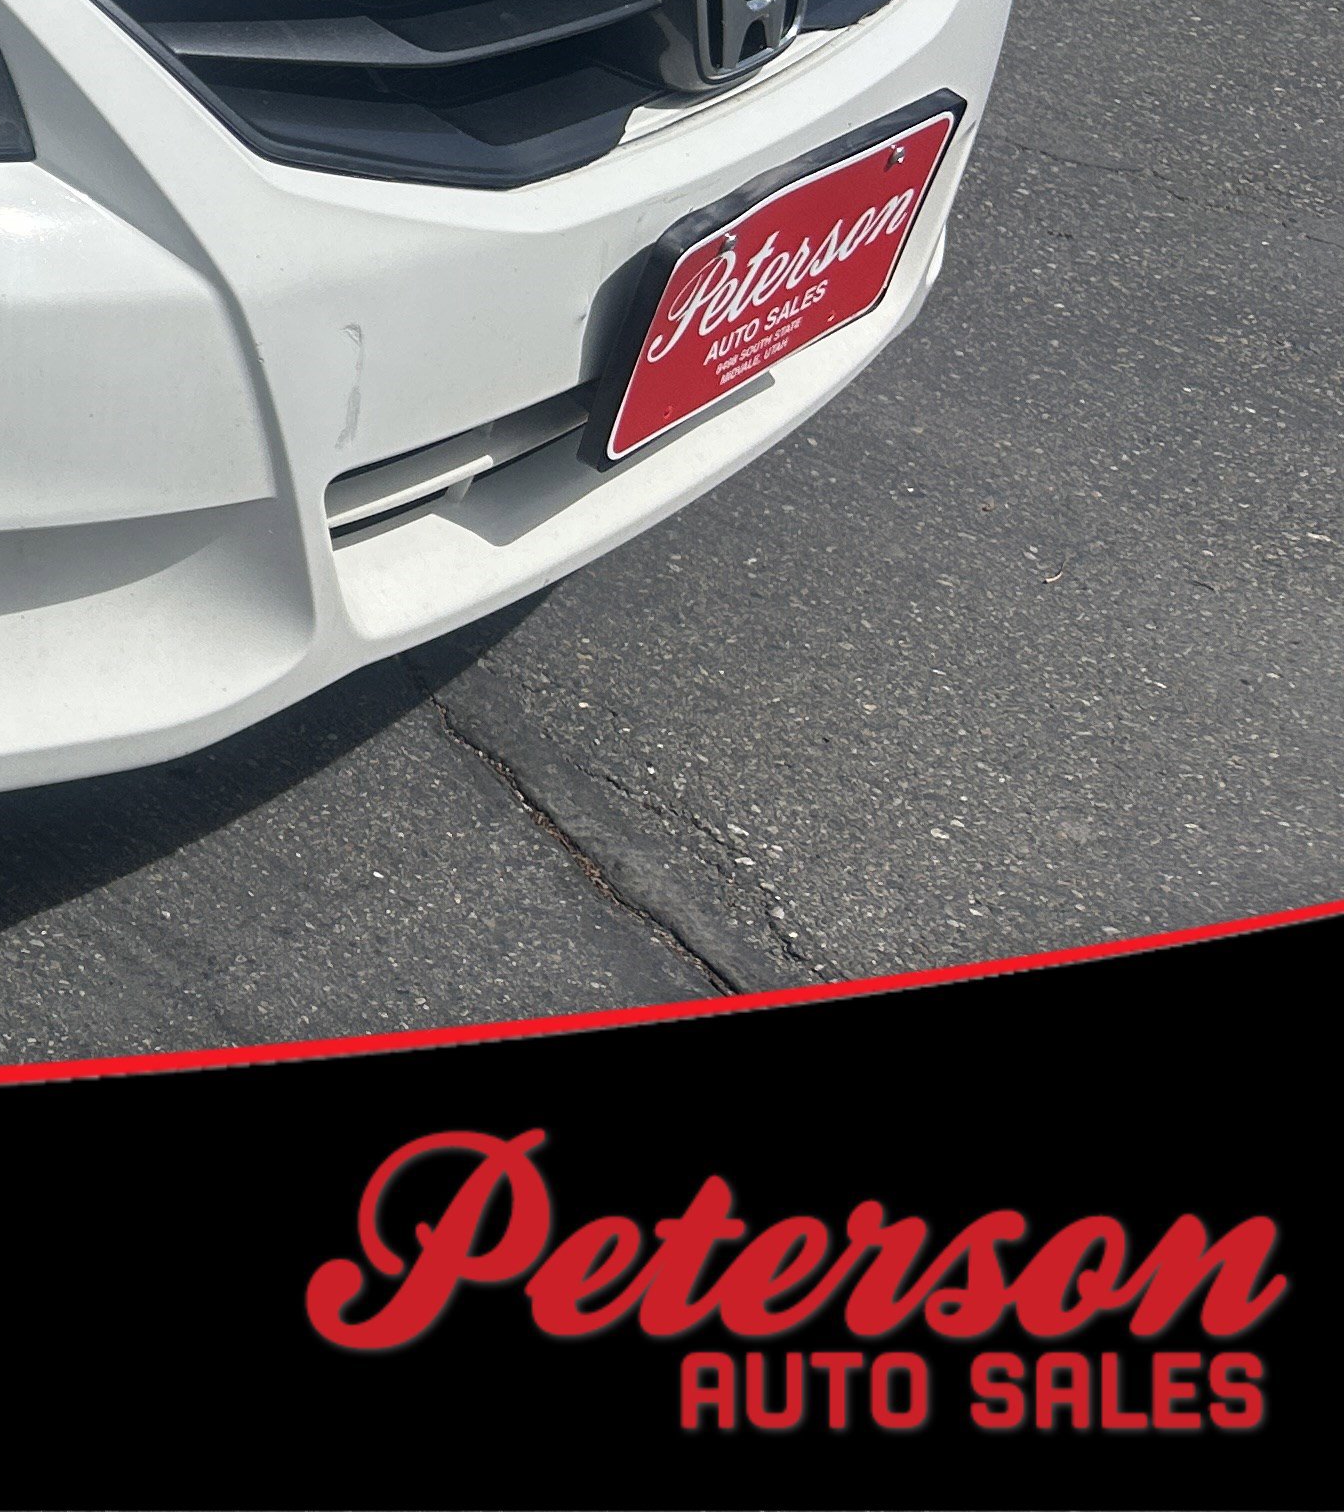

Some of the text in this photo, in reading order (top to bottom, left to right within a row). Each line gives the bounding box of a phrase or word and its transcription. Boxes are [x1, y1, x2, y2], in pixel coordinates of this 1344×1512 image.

[646, 188, 915, 364] Peterson
[703, 279, 828, 366] AUTO SALES
[738, 334, 773, 361] SOUTH
[773, 316, 803, 342] STATE
[763, 336, 789, 360] UTAH
